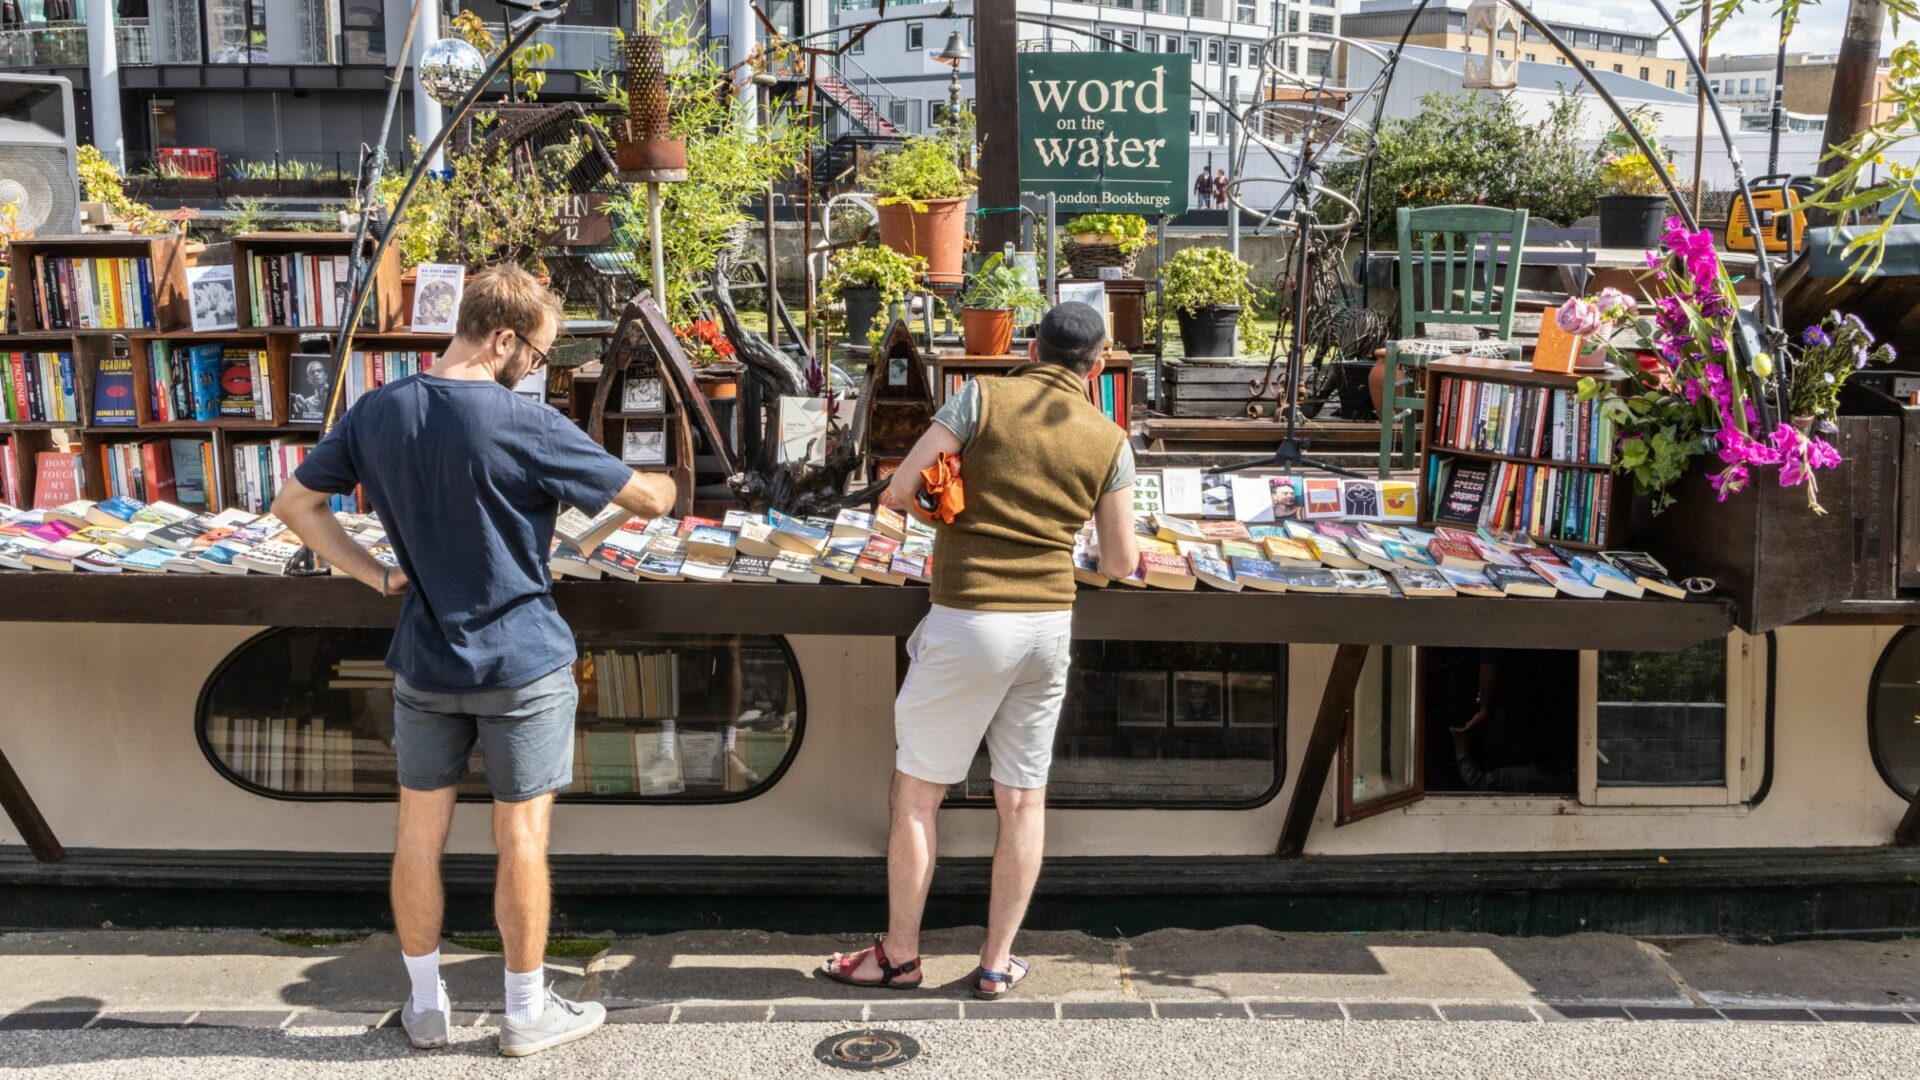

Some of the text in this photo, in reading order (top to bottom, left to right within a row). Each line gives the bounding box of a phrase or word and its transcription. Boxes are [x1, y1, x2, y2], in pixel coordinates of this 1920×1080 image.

[1028, 65, 1168, 114] word
[1056, 115, 1105, 130] on the
[1034, 131, 1166, 168] water
[1054, 191, 1098, 204] ondon
[1102, 192, 1171, 208] Bookbarge
[564, 225, 579, 241] 12
[102, 282, 113, 320] RETREAT
[13, 362, 25, 406] PACHINKO
[1453, 480, 1485, 492] SPEECH
[44, 492, 70, 500] HAIR
